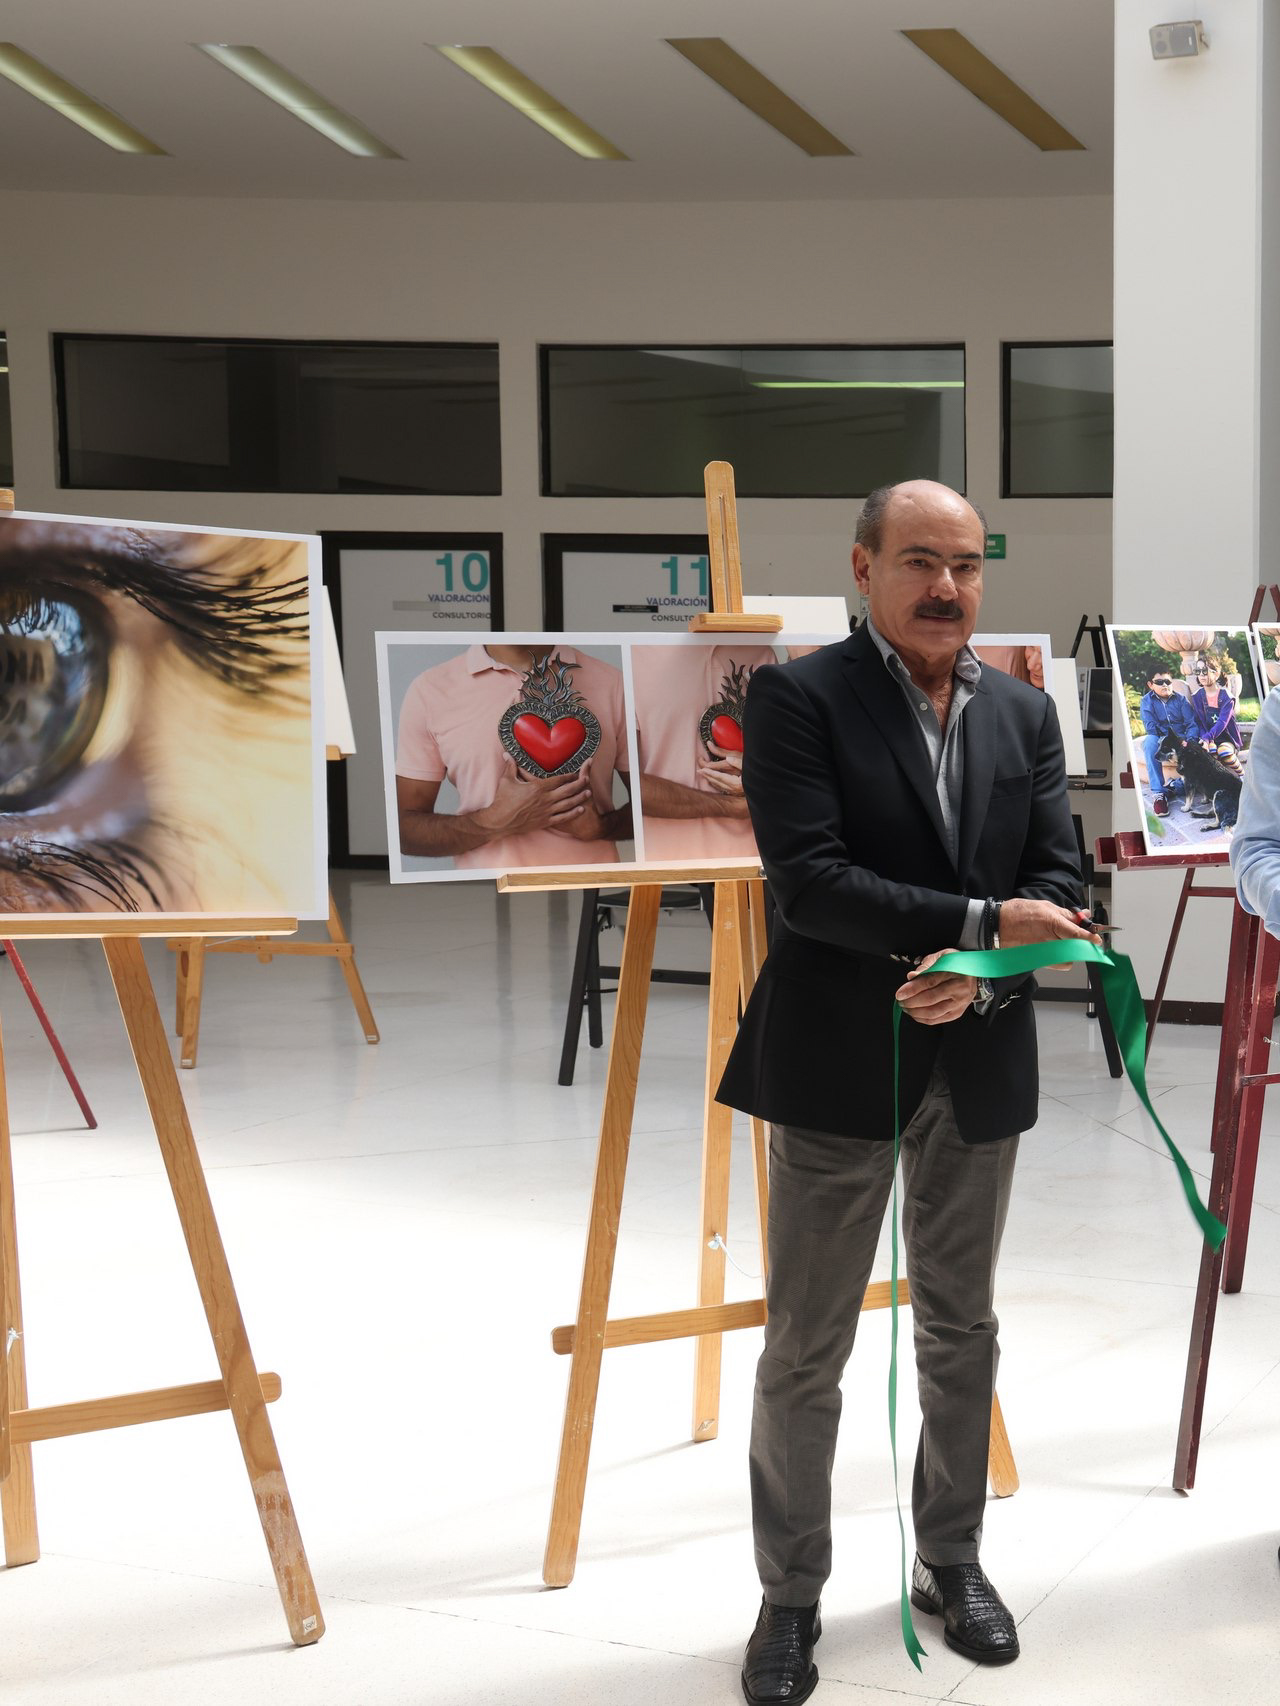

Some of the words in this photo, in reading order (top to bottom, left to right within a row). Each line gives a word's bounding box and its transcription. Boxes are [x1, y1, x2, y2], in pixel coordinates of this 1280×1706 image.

[435, 552, 489, 593] 10
[661, 555, 708, 596] 11
[428, 592, 491, 603] VALORACIÓN
[646, 597, 708, 606] VALORACIÓN
[432, 611, 492, 620] CONSULTORIO
